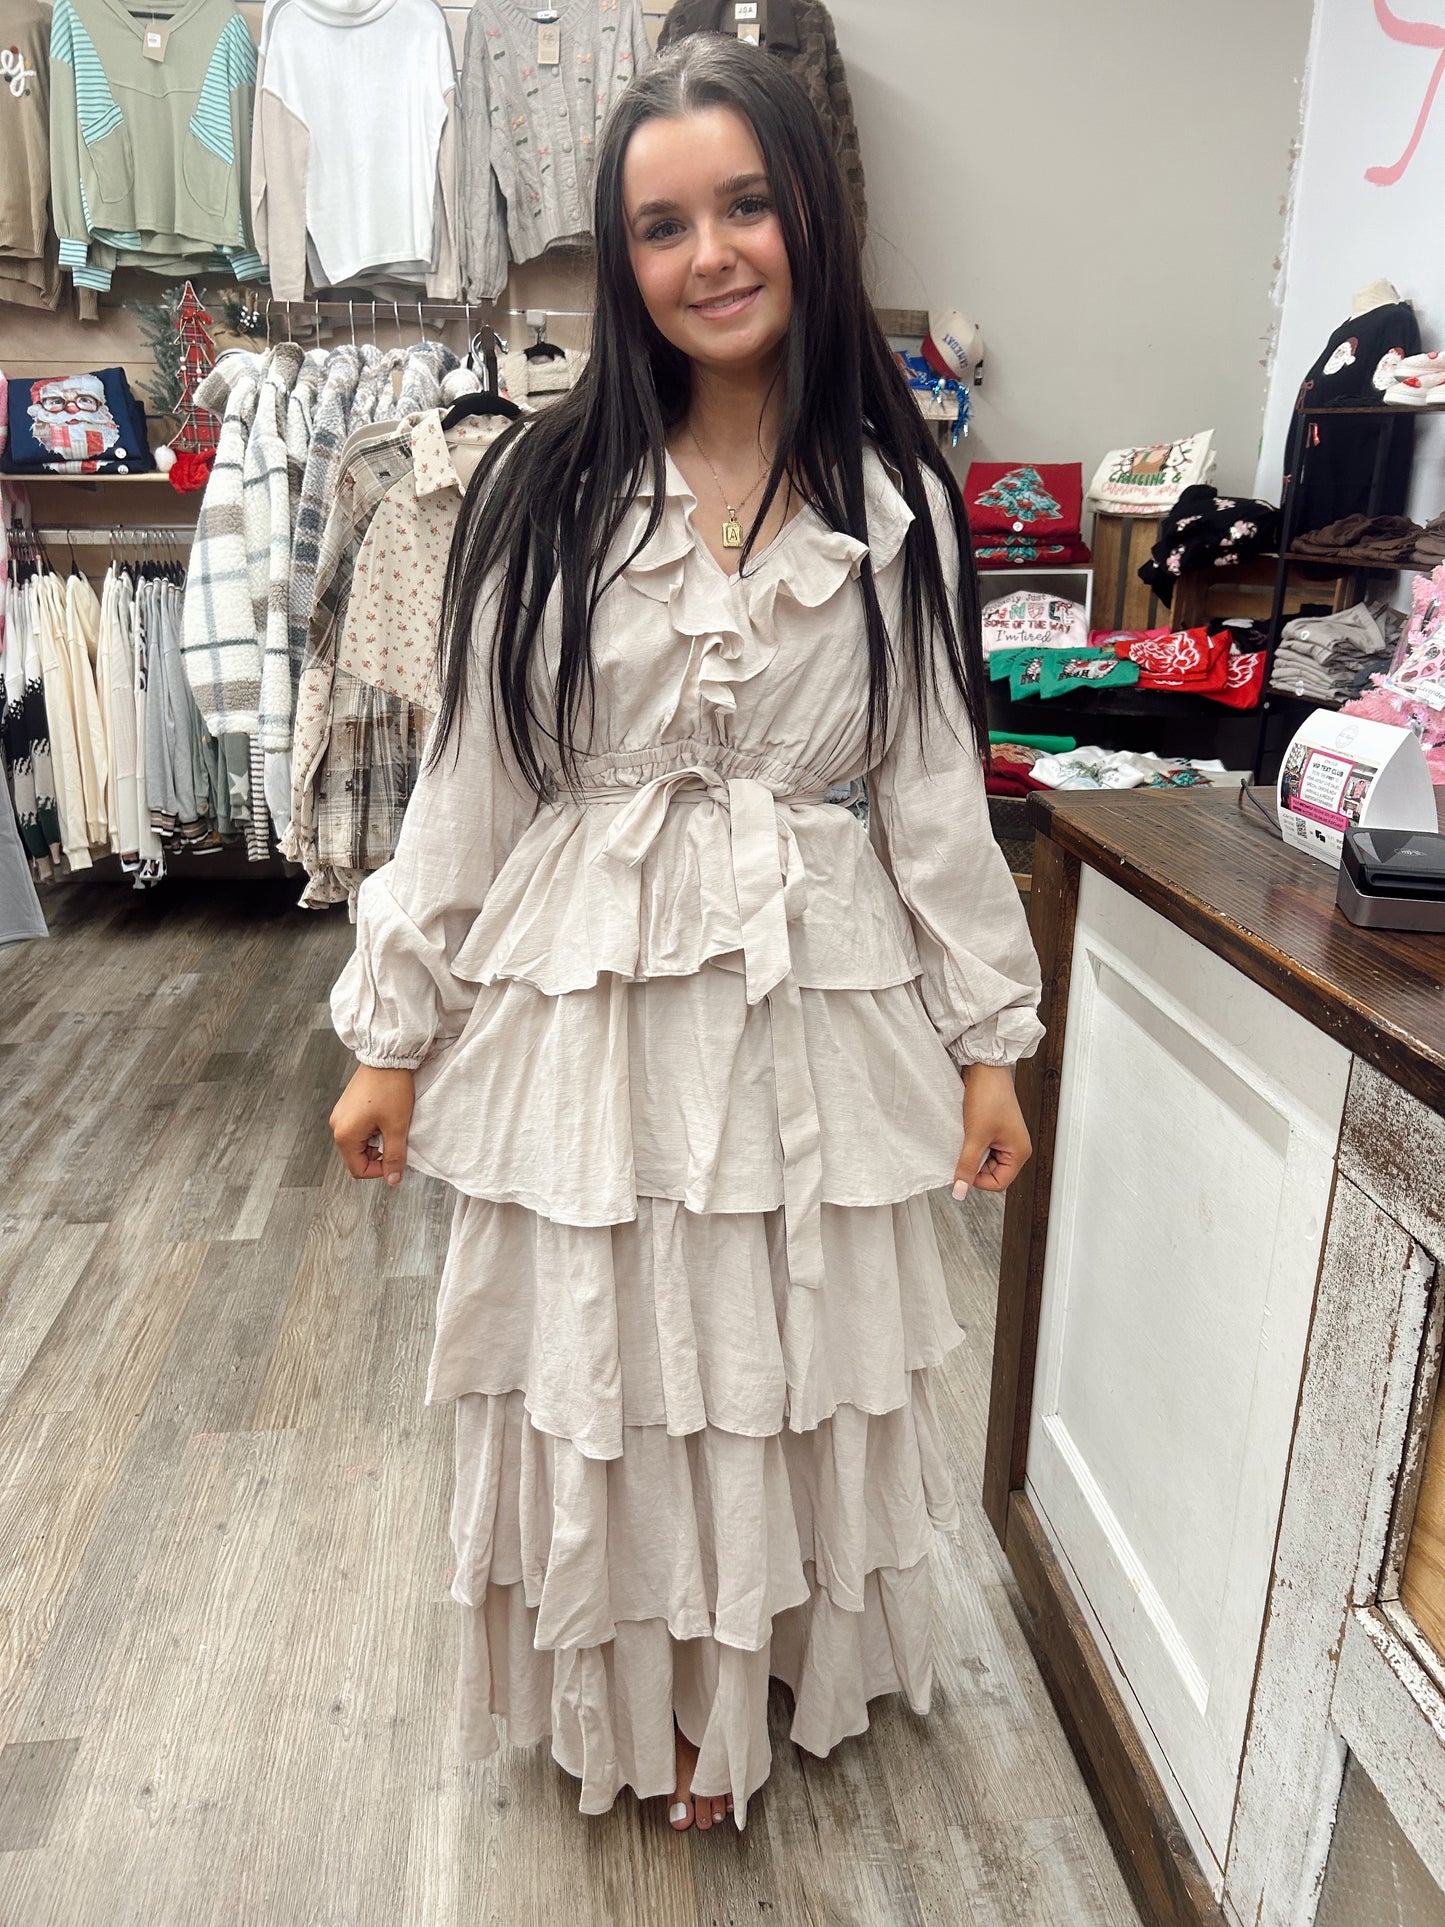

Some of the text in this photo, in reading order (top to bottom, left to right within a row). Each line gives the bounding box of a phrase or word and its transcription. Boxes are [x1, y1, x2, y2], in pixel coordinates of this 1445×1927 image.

[984, 619, 1072, 634] SOME OF THE WAY
[1018, 630, 1052, 643] tired
[1331, 769, 1343, 777] CLUB
